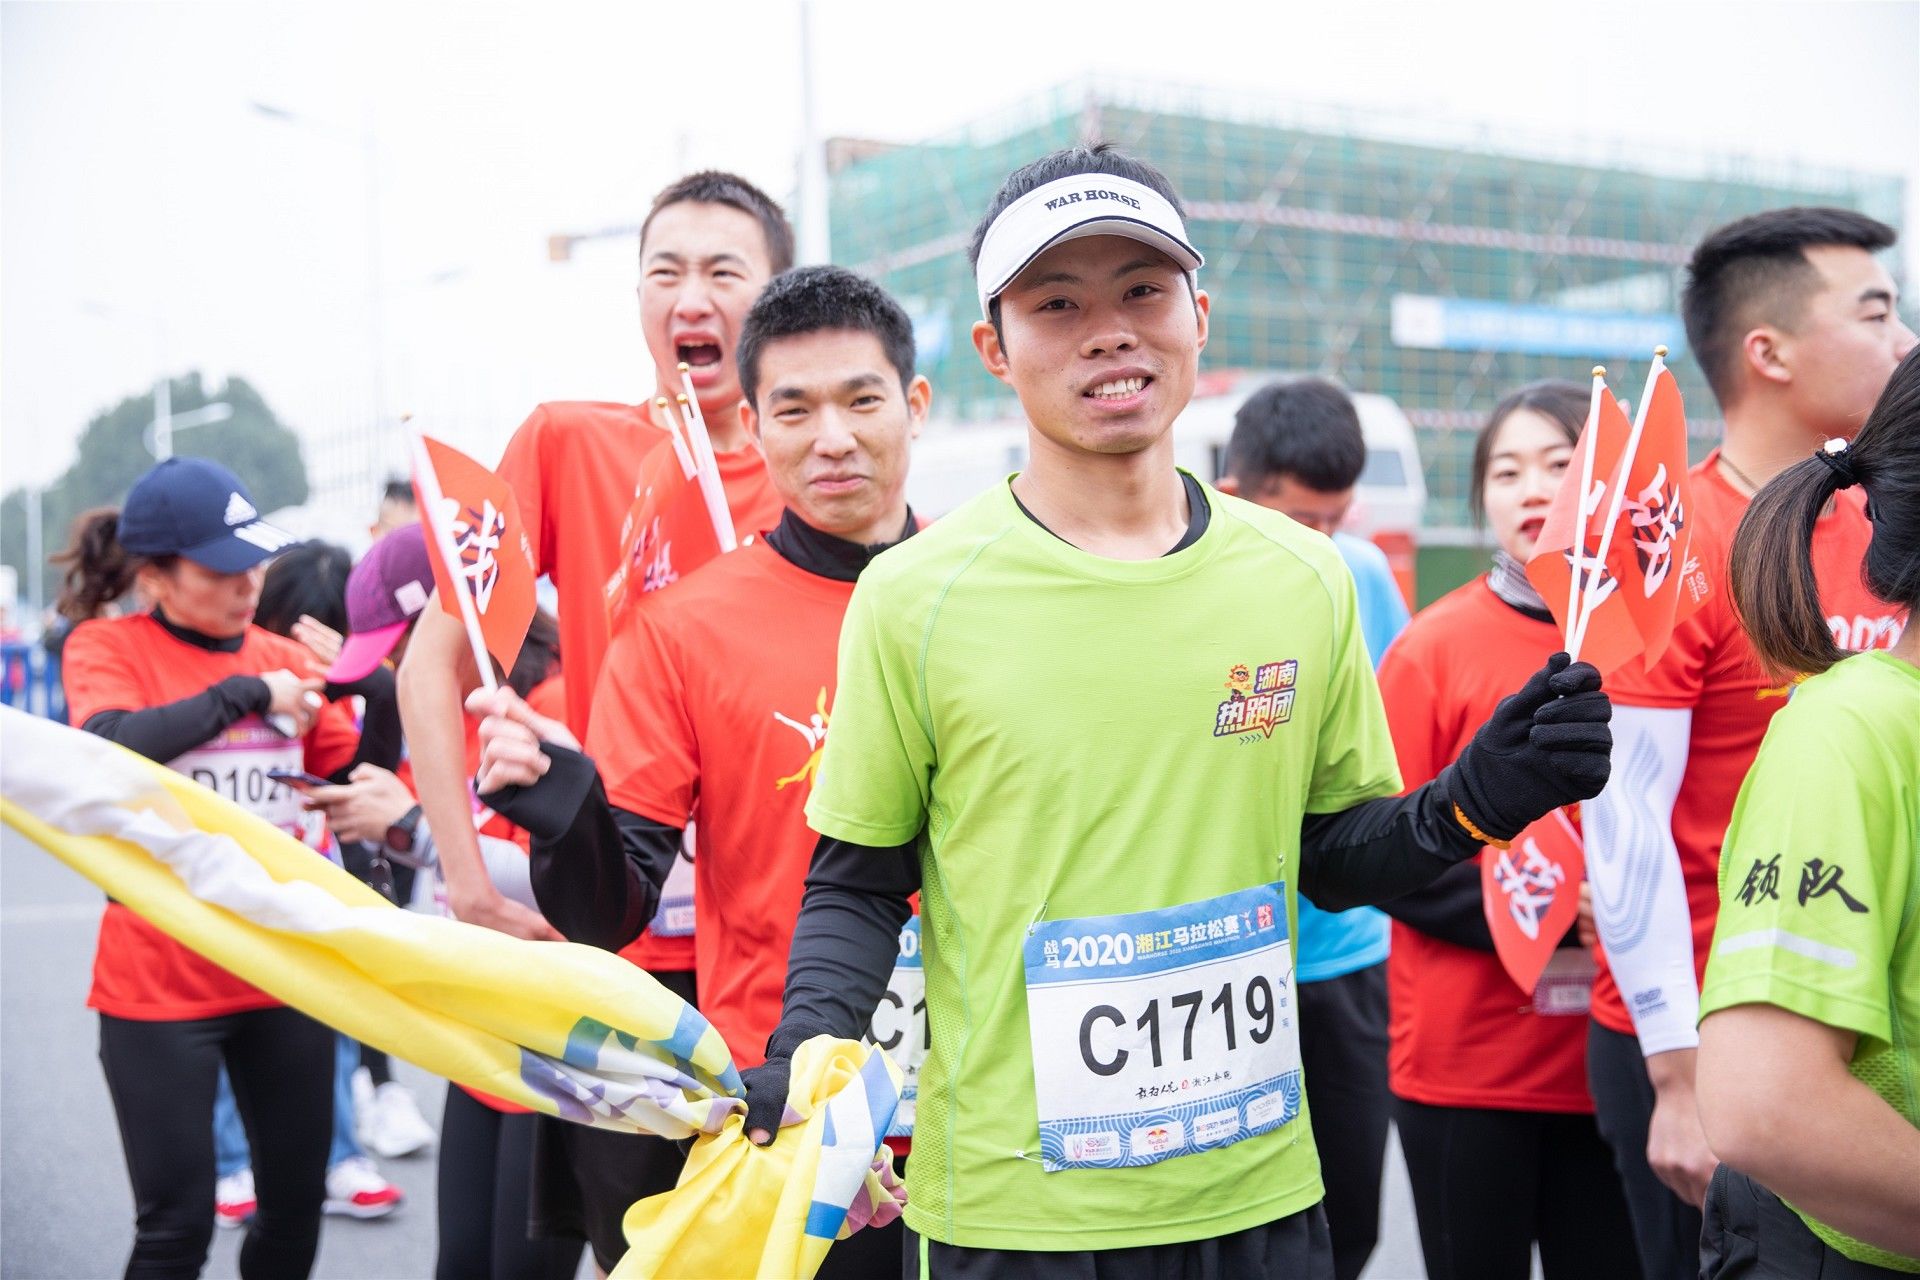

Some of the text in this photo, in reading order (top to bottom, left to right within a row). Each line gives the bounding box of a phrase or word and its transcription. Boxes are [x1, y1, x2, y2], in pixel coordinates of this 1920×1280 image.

[1044, 189, 1141, 211] WAR HORSE
[1256, 661, 1297, 692] 湖南
[1215, 690, 1295, 736] 热跑团
[1734, 853, 1870, 914] 领队
[1044, 939, 1060, 969] 战马
[1061, 932, 1135, 969] 2020
[1079, 975, 1275, 1077] C1719
